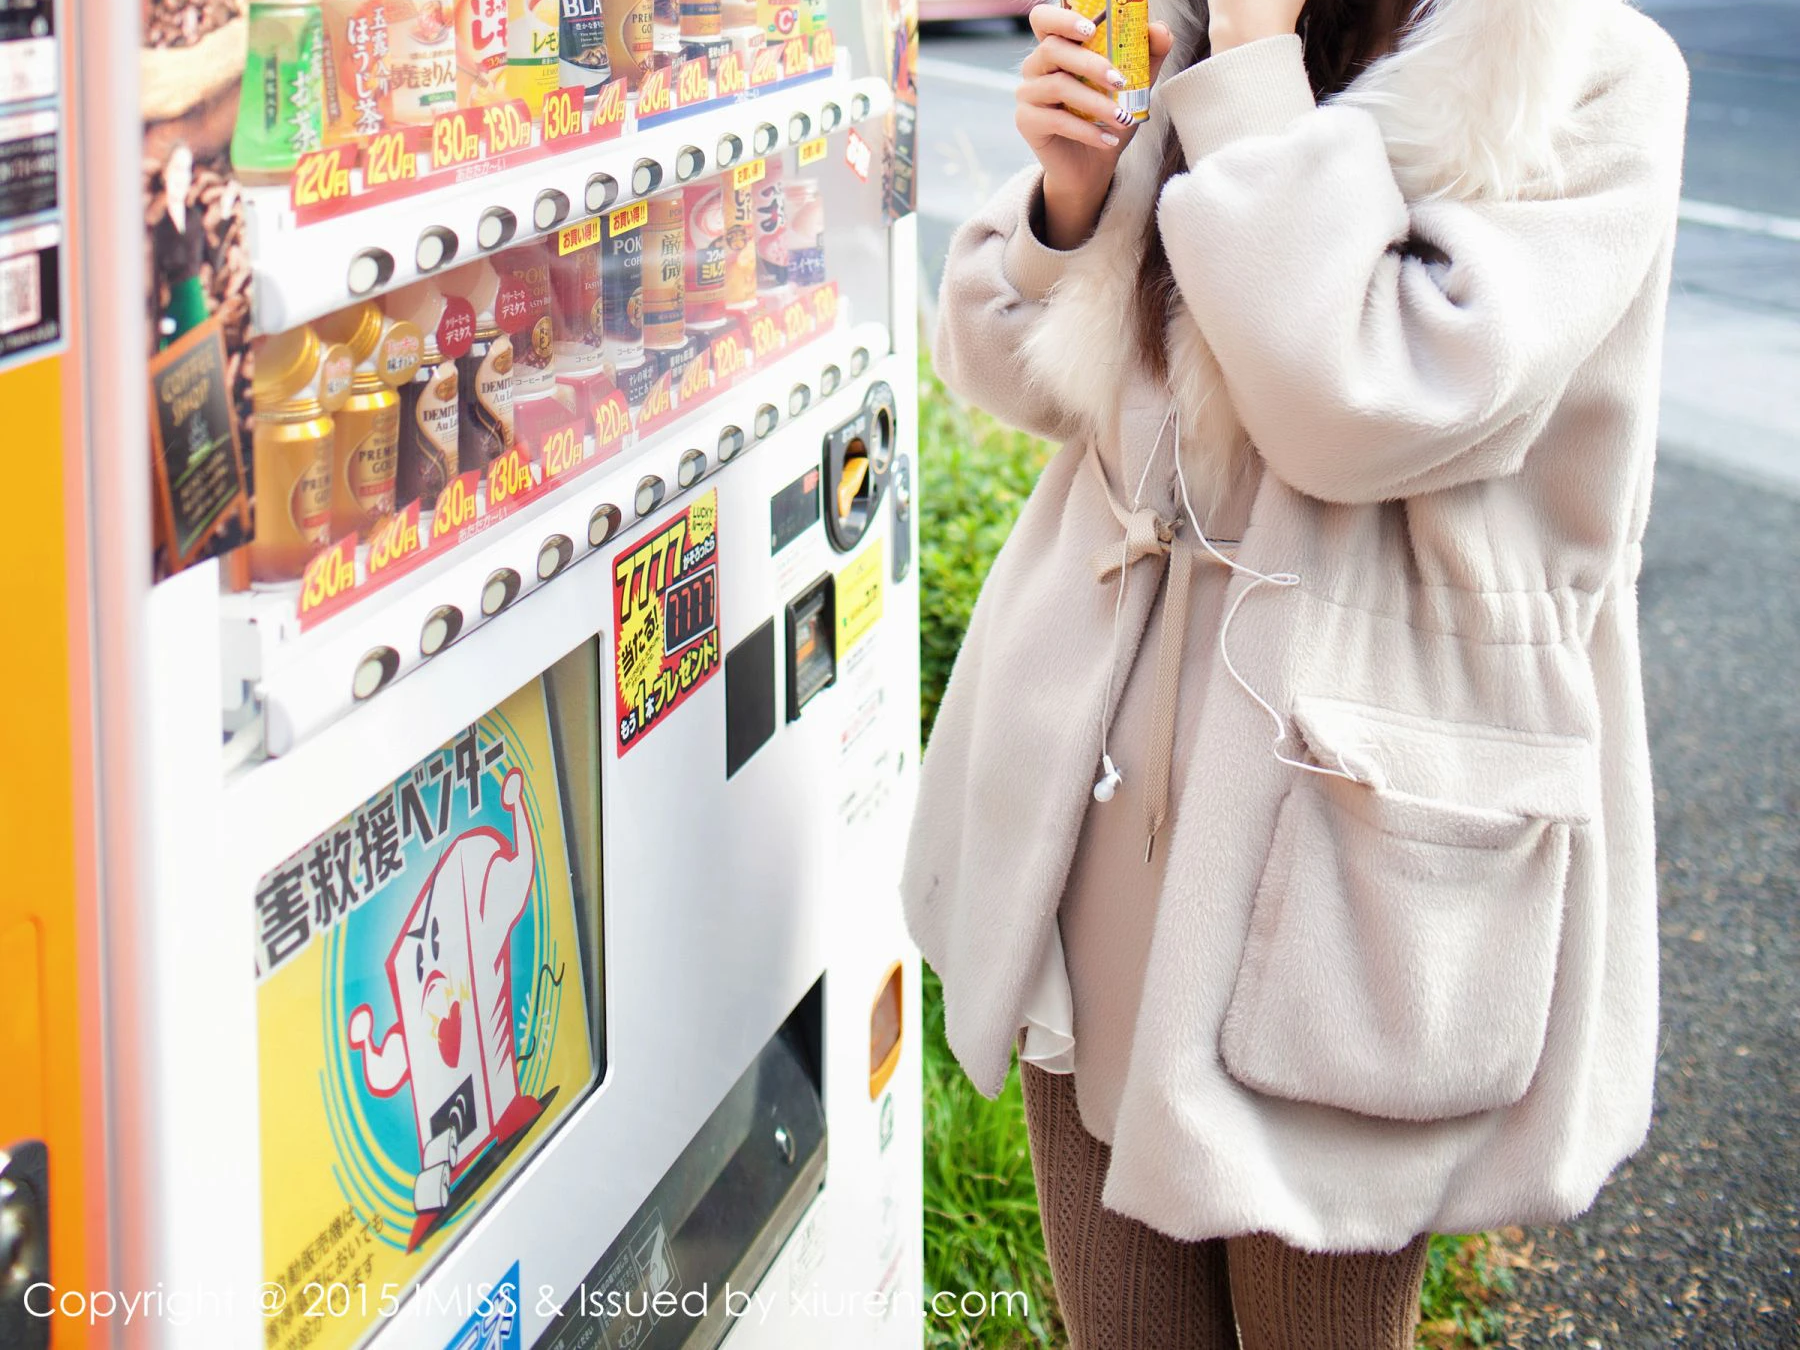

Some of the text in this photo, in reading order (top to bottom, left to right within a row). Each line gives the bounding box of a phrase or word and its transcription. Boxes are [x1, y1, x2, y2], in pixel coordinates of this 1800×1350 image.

[348, 17, 383, 135] ほうじ茶
[679, 61, 709, 104] 130円
[433, 115, 479, 168] 130円
[484, 105, 531, 151] 130円
[543, 92, 580, 140] 130円
[295, 150, 350, 206] 120円
[367, 132, 416, 184] 120円
[563, 221, 598, 249] お買い得!!
[613, 203, 646, 230] お買い得!!
[596, 398, 630, 448] 120円
[488, 449, 531, 507] 130円
[543, 427, 584, 477] 120円
[433, 479, 477, 539] 130円
[692, 506, 714, 519] LUCKY
[616, 518, 687, 618] 7777
[682, 534, 717, 571] がそろったら
[301, 546, 356, 612] 130円
[669, 574, 715, 637] 7777
[621, 603, 660, 680] 当たる!
[254, 718, 505, 979] 害救援ベンダー
